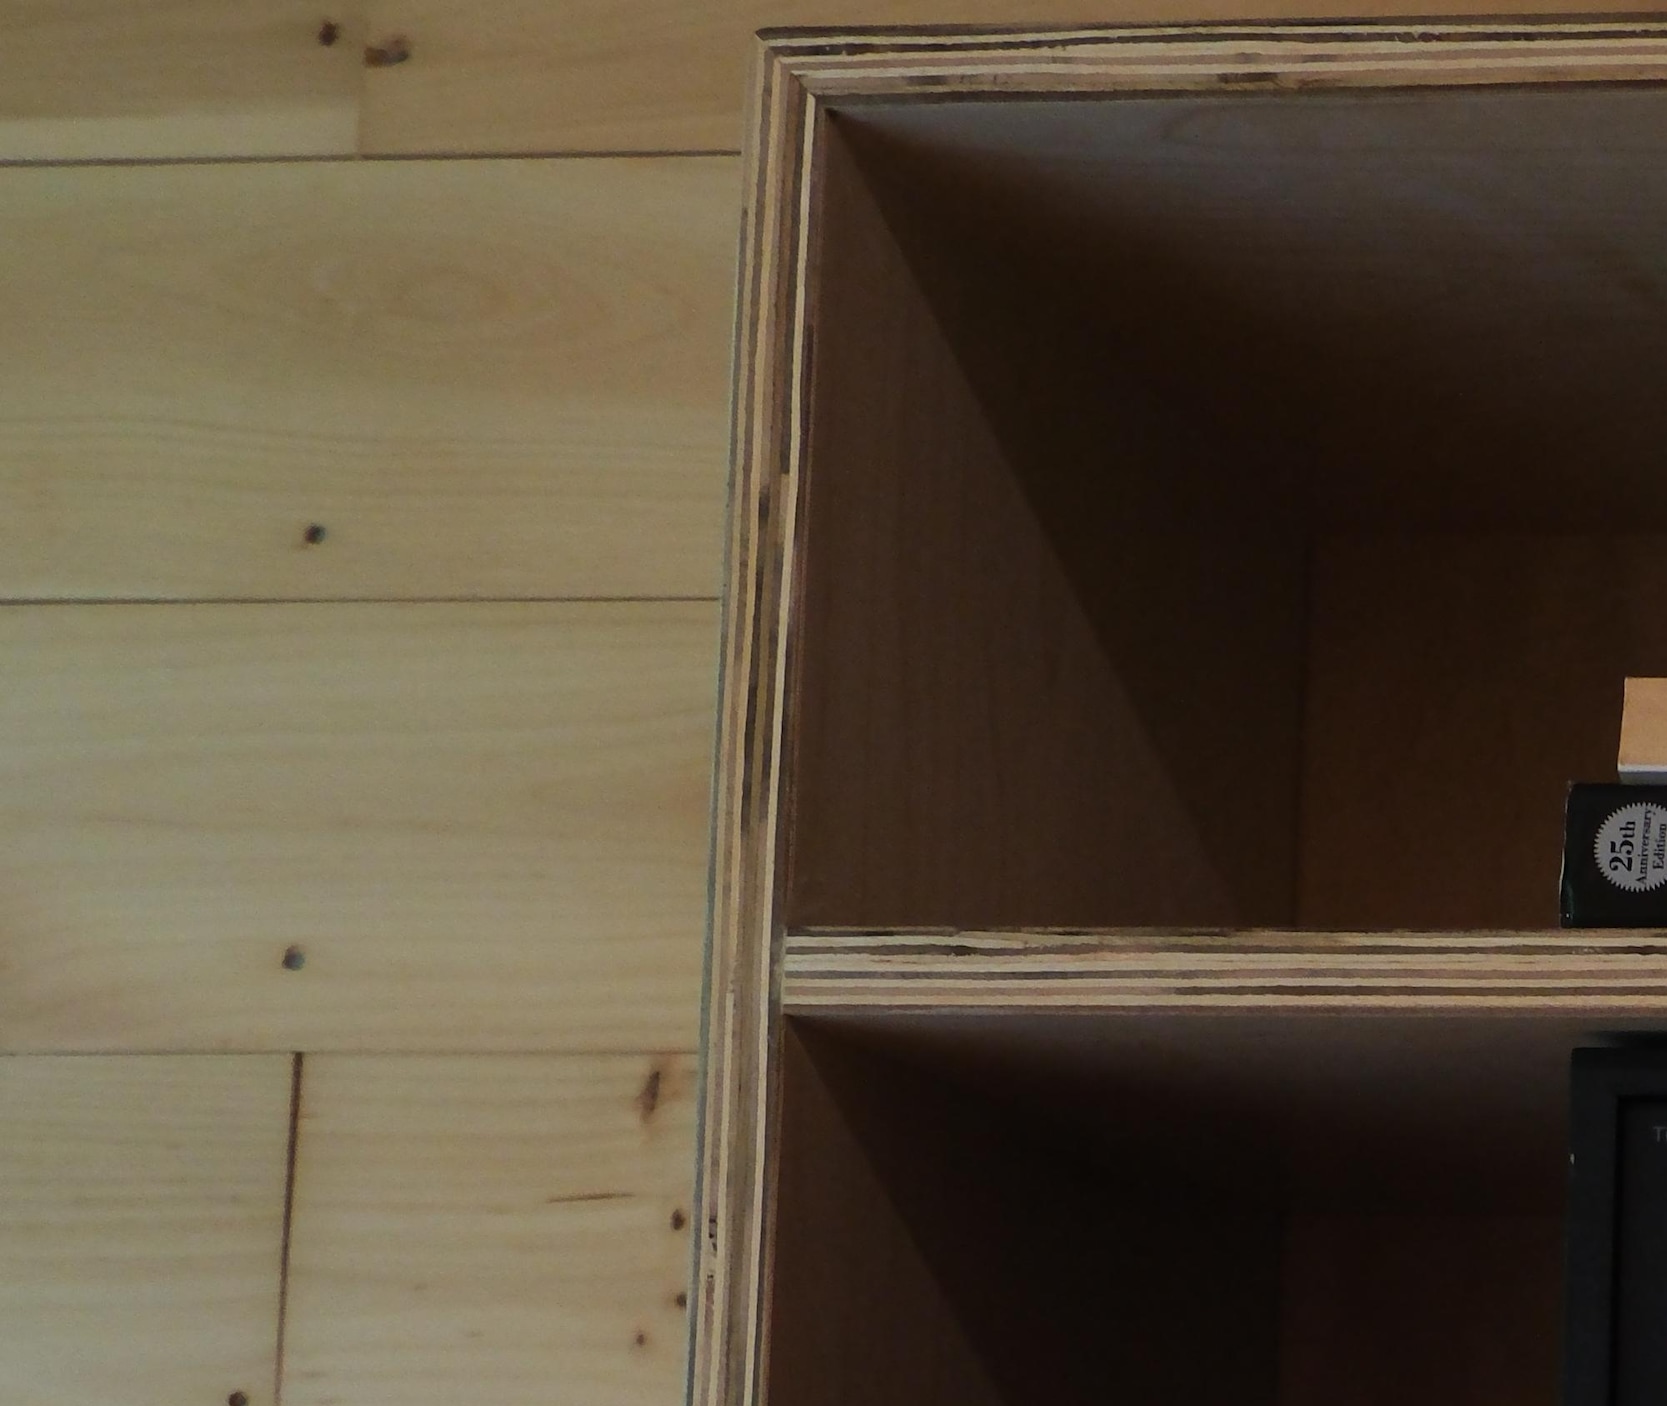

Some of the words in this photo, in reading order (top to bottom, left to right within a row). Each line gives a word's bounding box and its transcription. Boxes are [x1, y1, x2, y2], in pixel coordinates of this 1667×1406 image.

[1609, 820, 1637, 873] 25th
[1635, 807, 1656, 886] Anniversary
[1653, 822, 1667, 870] Edition
